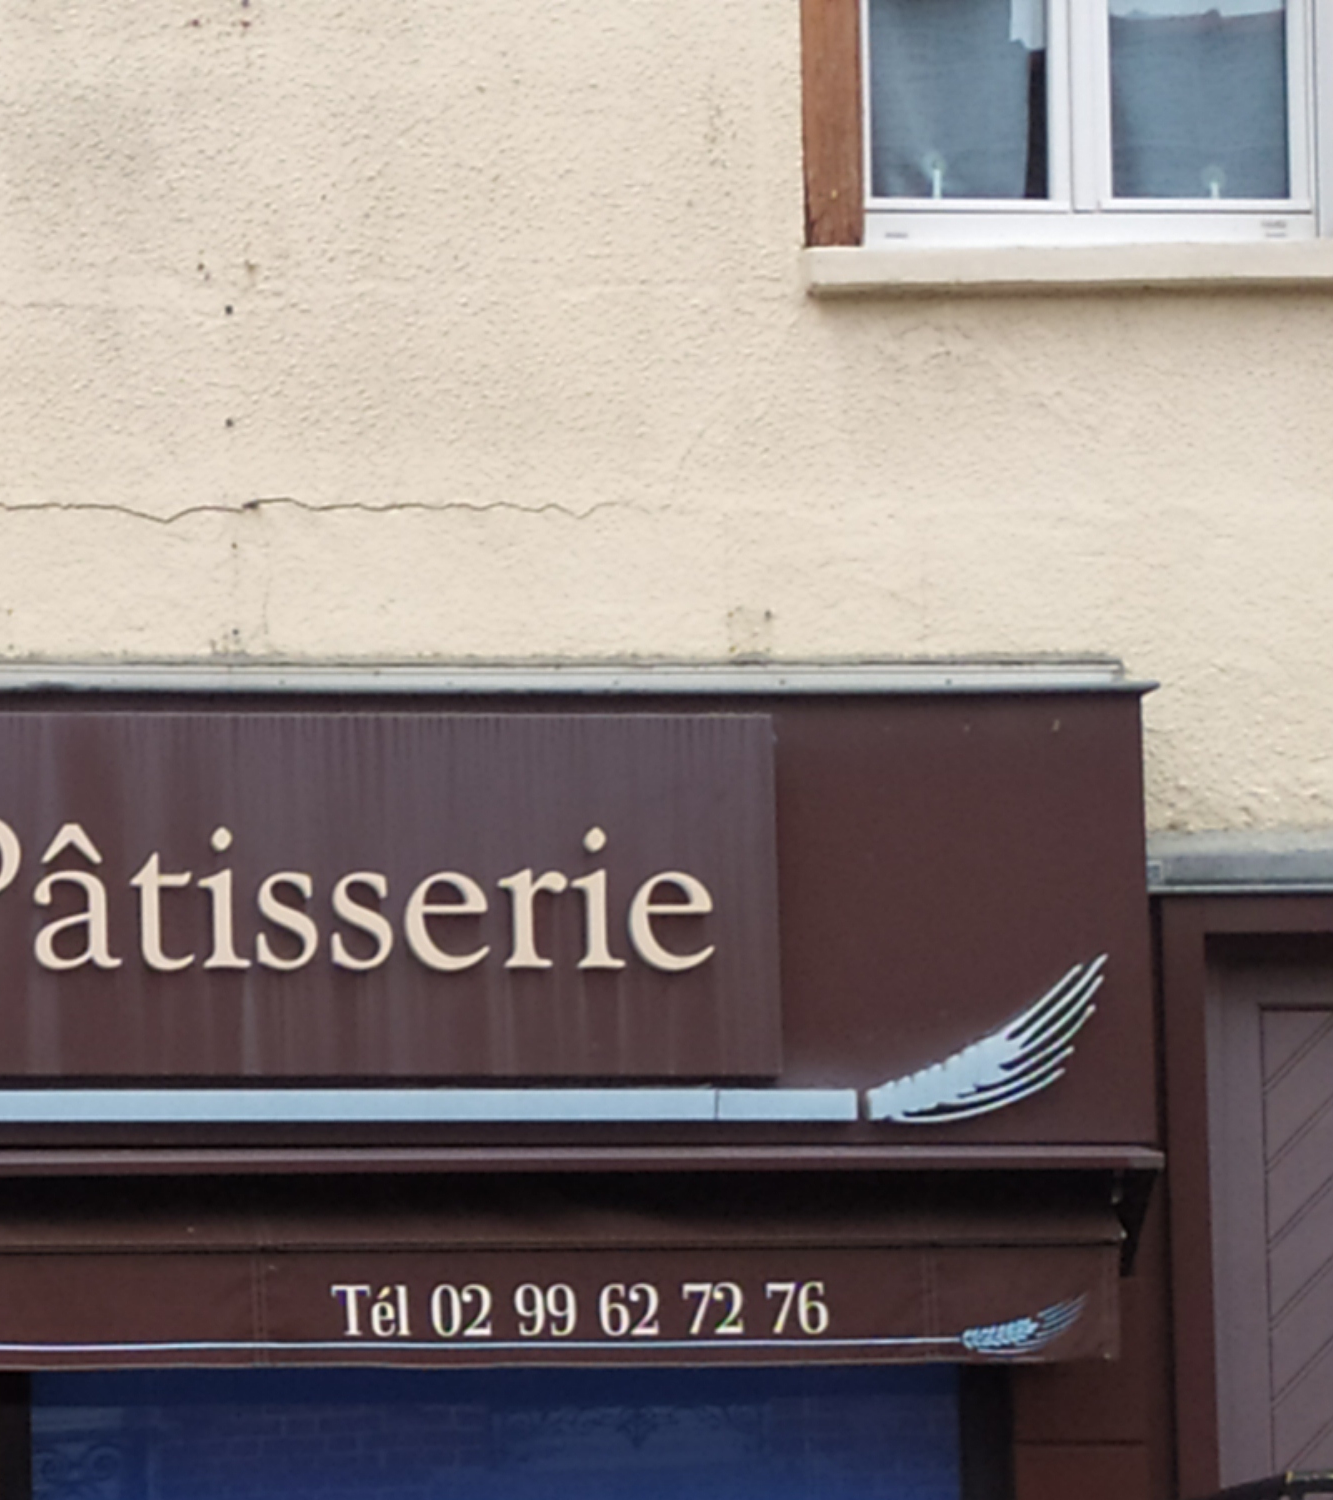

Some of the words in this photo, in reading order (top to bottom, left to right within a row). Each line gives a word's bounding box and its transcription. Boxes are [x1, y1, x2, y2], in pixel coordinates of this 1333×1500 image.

[333, 1282, 411, 1338] Tél
[431, 1282, 492, 1338] 02
[515, 1282, 575, 1338] 99
[599, 1282, 659, 1338] 62
[683, 1282, 743, 1338] 72
[765, 1281, 829, 1336] 76
